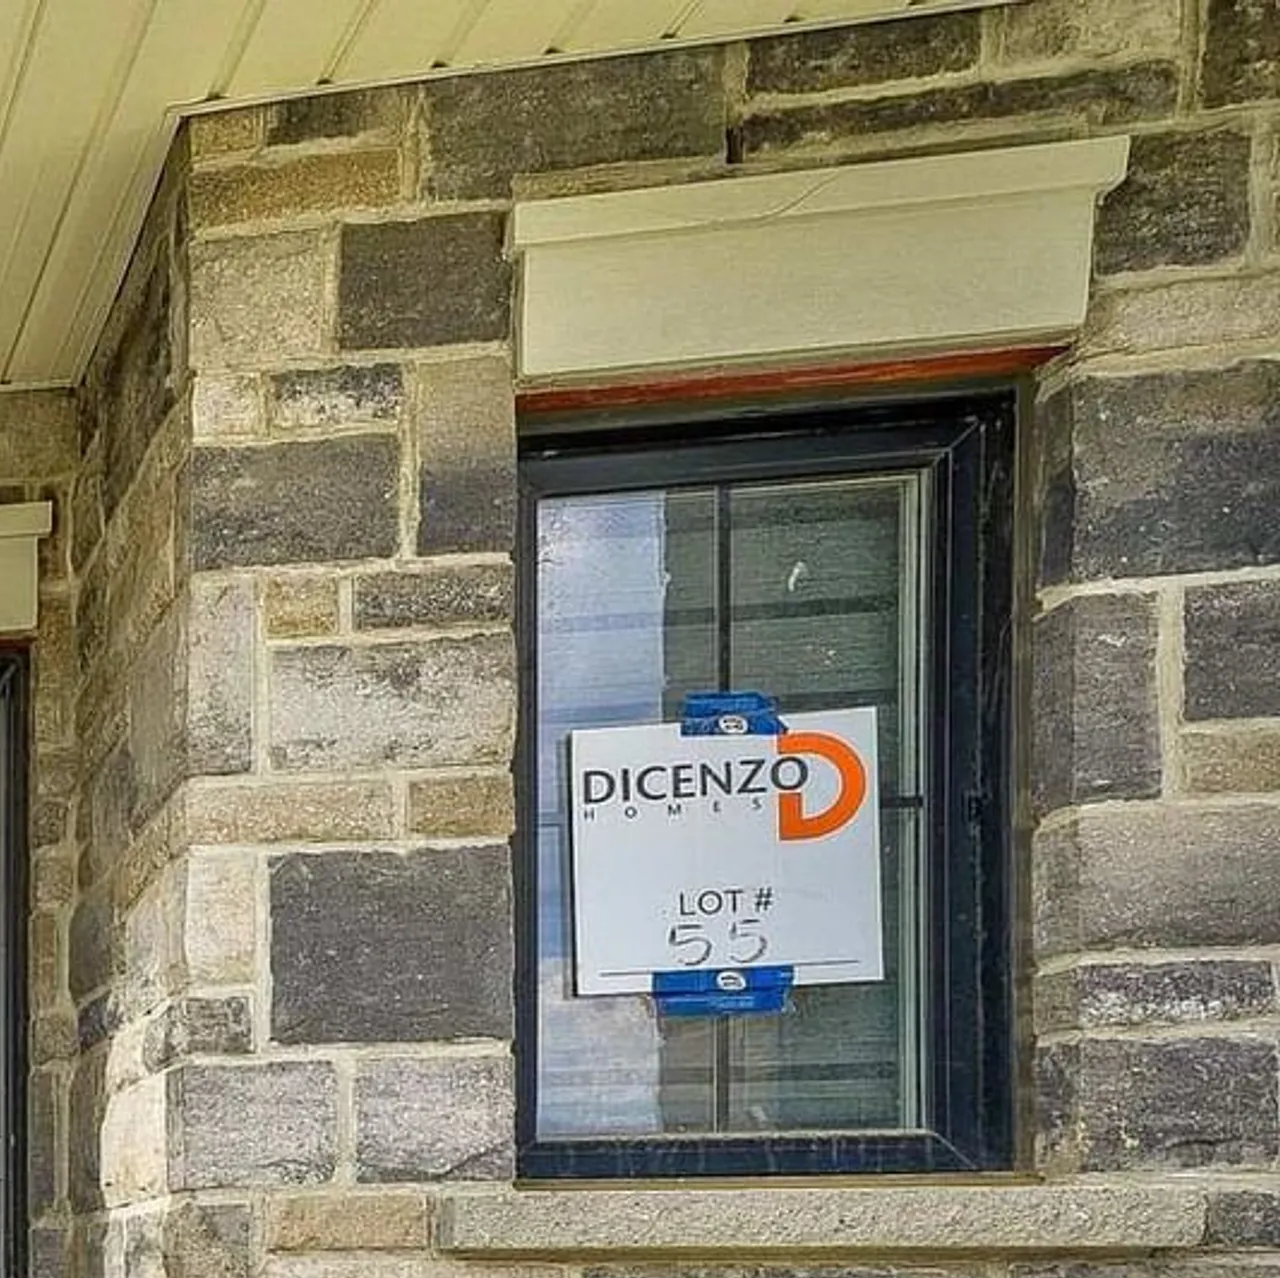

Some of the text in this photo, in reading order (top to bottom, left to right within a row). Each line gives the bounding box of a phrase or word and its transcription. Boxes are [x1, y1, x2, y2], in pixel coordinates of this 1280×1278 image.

[582, 756, 809, 805] DICENZO
[583, 798, 762, 821] HOMES
[679, 889, 744, 916] LOT
[668, 919, 768, 966] 55
